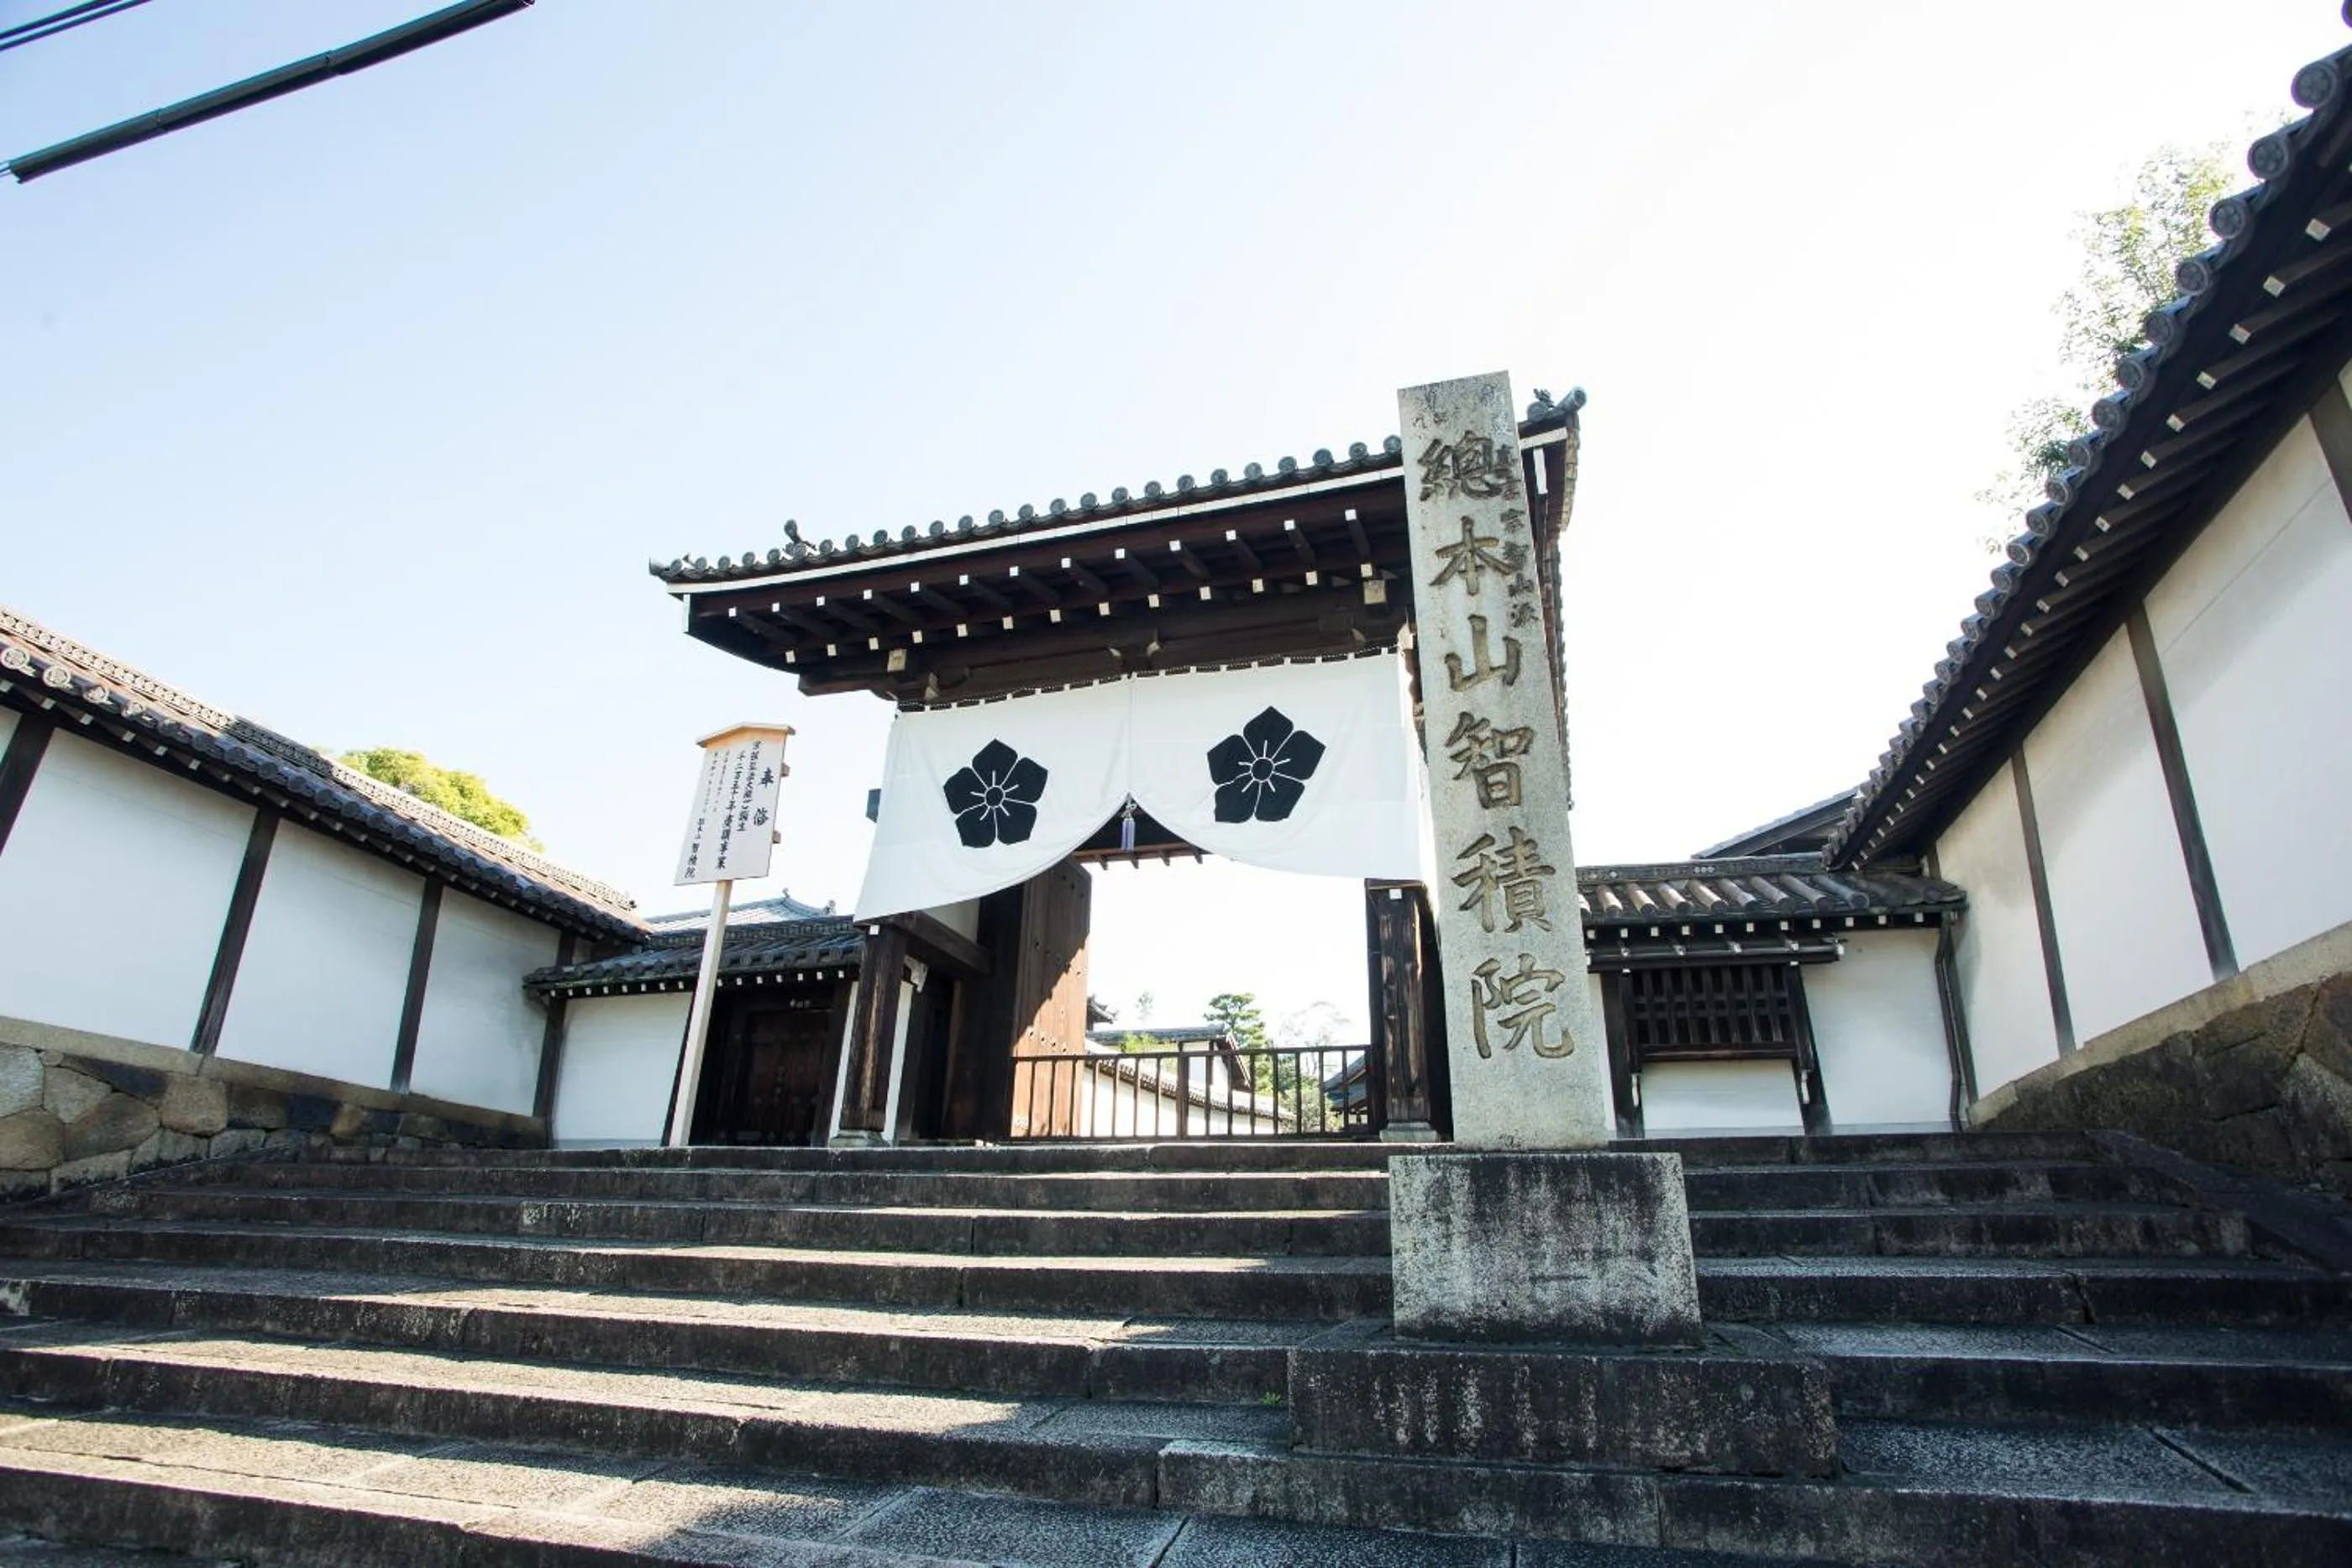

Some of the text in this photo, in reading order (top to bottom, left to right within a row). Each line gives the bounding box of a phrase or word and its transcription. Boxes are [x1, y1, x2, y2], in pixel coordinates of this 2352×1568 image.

[1417, 430, 1575, 1059] 總本山智積院
